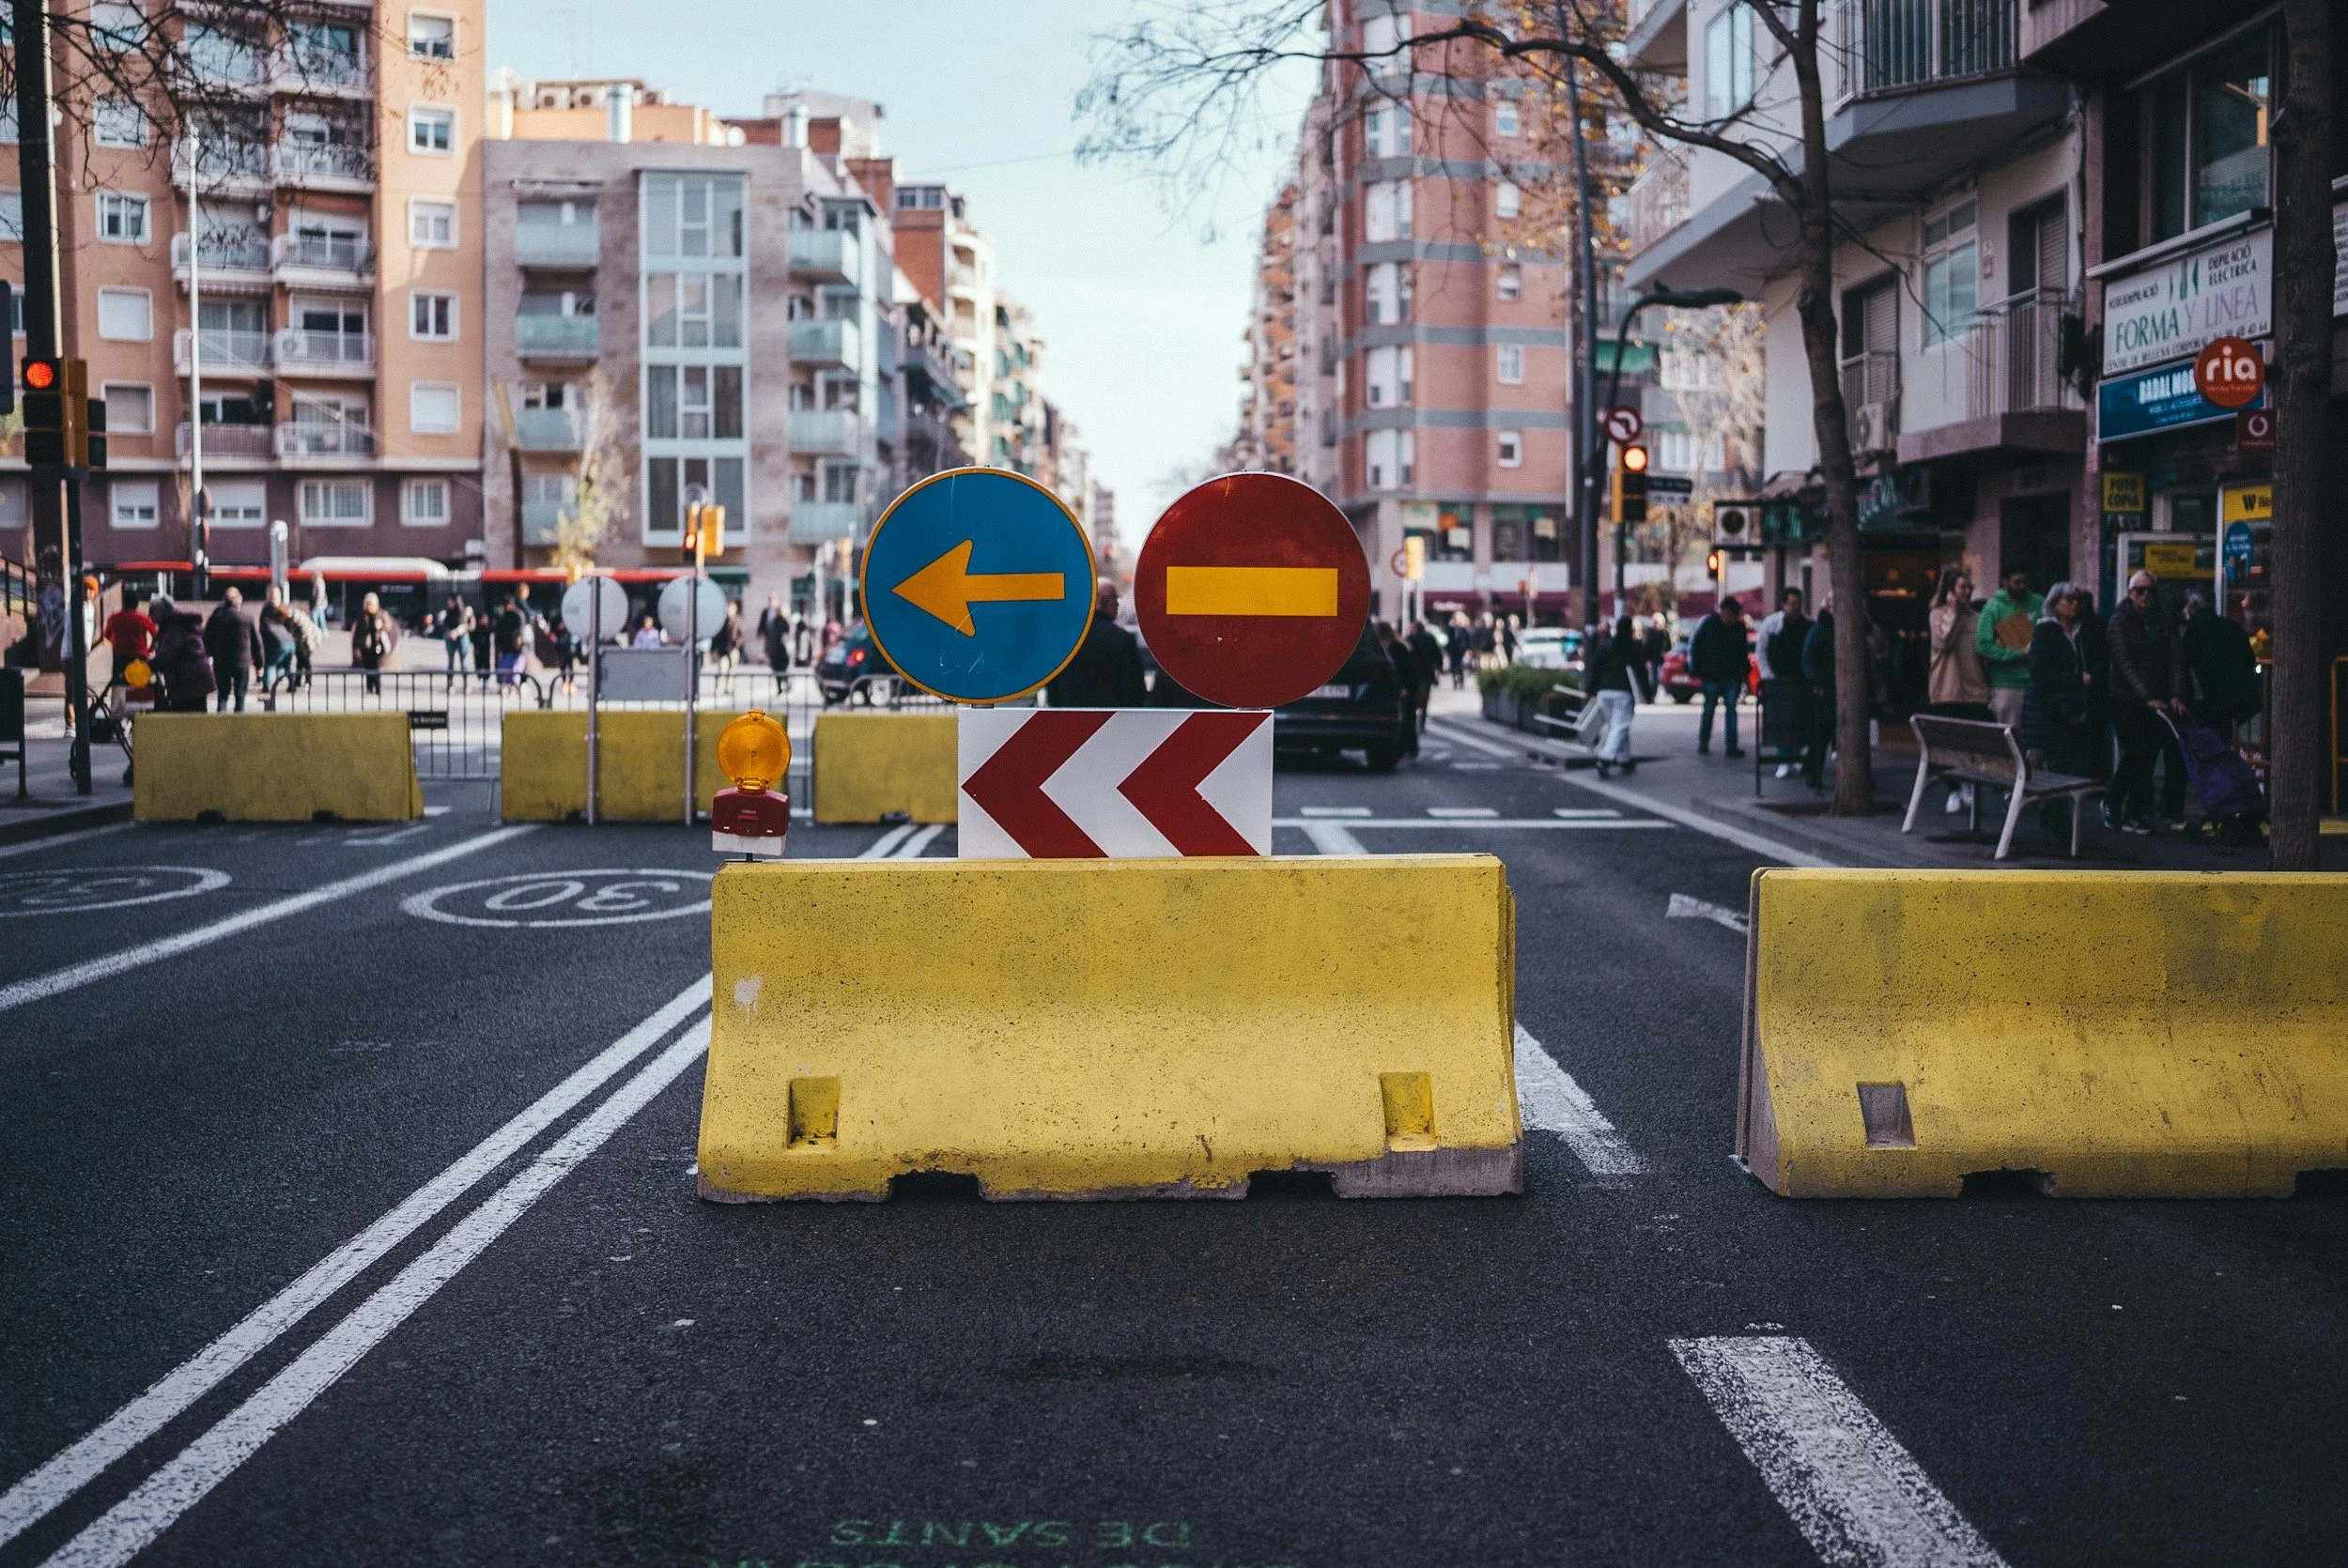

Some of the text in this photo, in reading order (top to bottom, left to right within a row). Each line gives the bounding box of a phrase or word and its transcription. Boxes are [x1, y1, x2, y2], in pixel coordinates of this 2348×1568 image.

[2115, 306, 2180, 353] FORMA
[2185, 299, 2196, 332] Y
[2206, 345, 2257, 382] ria
[486, 881, 680, 911] 30
[829, 1519, 1191, 1548] DE SANTS
